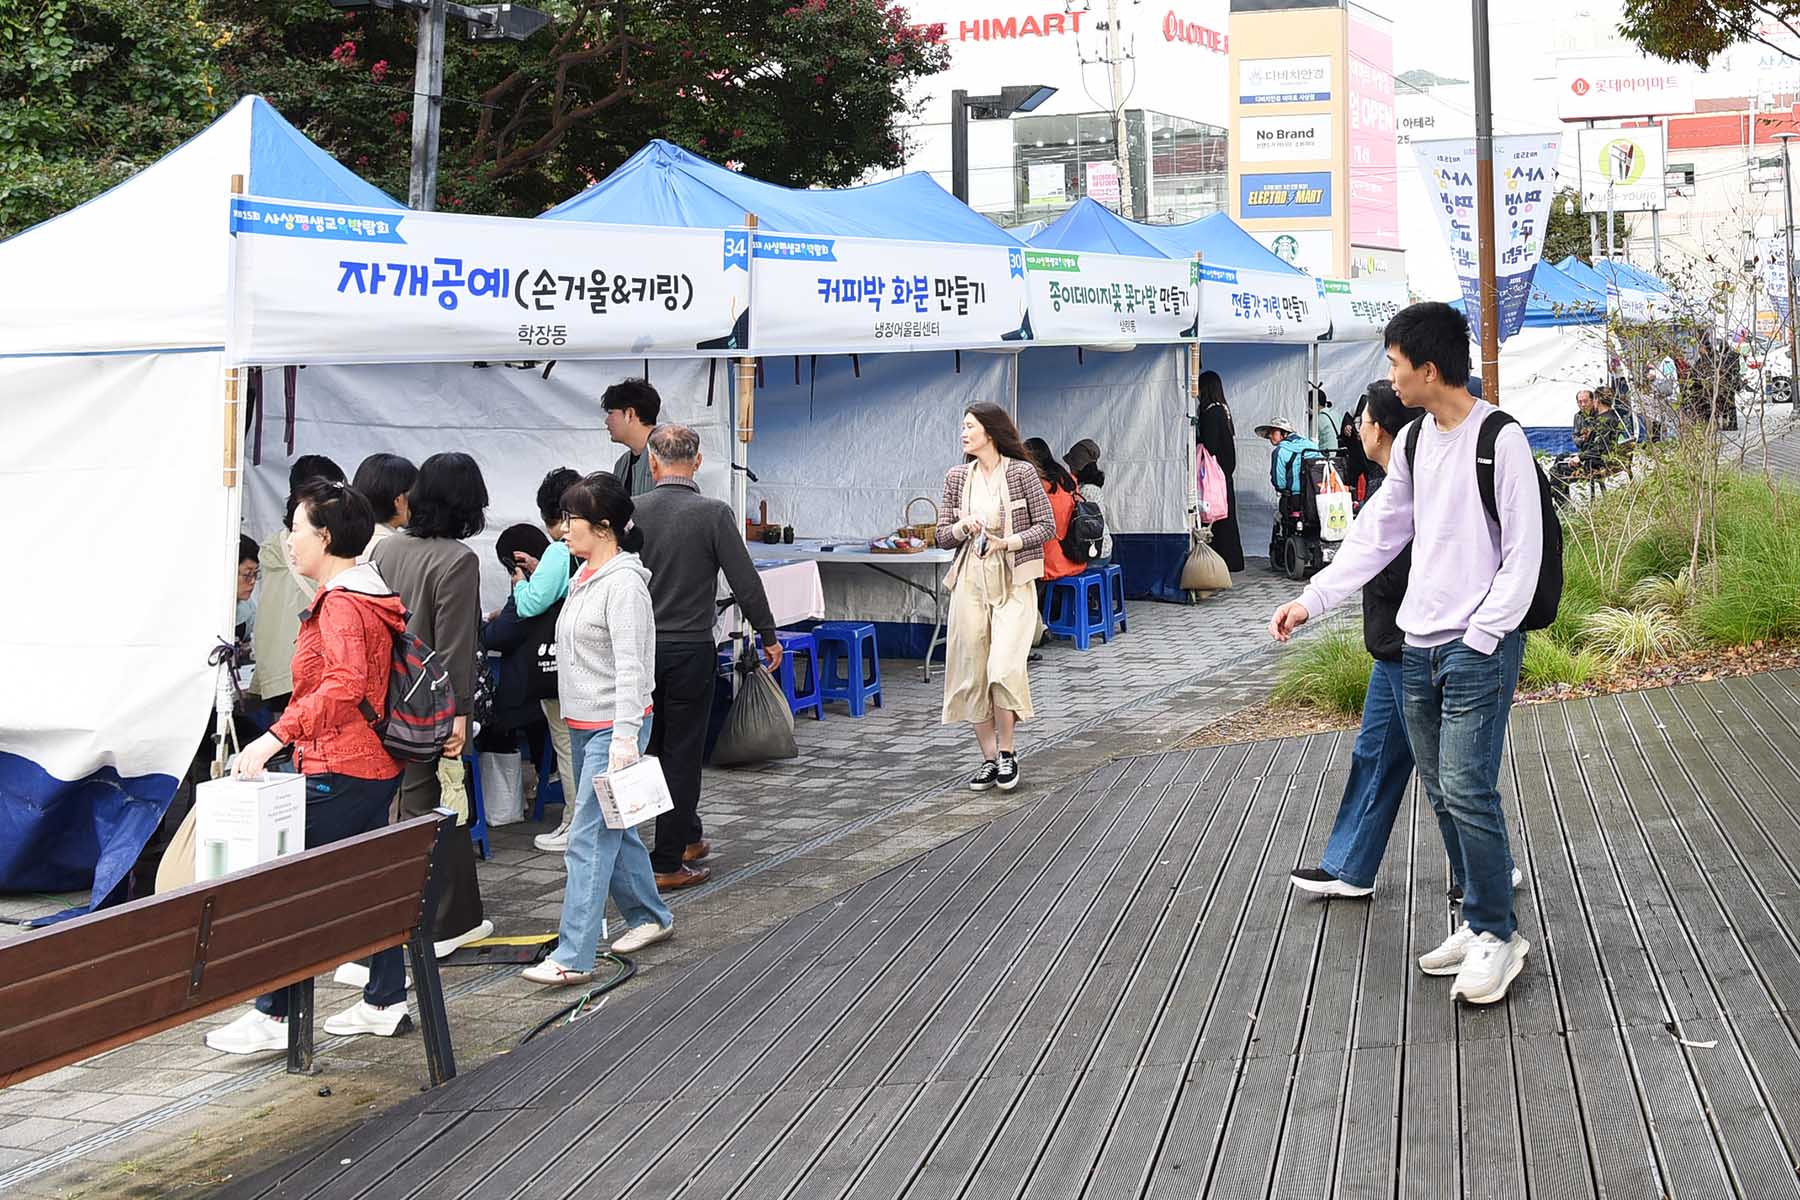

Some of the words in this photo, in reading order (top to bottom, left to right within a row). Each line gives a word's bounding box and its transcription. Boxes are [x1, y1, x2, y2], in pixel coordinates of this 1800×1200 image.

[959, 11, 1086, 42] HIMART
[1361, 97, 1393, 132] OPEN
[1256, 130, 1274, 140] No
[1276, 127, 1315, 140] Brand
[1247, 190, 1288, 206] ELECTRO
[1295, 189, 1324, 205] MART
[264, 212, 390, 237] 사상평생교육박람회
[724, 238, 747, 258] 34
[1010, 253, 1022, 269] 30
[337, 256, 695, 314] 자개공예(손거울&키링)
[817, 275, 886, 312] 커피박
[891, 275, 929, 313] 화분
[934, 276, 986, 316] 만들기
[1048, 280, 1122, 314] 종이데이지꽃
[1123, 283, 1158, 315] 꽃다발
[1159, 286, 1190, 317] 만들기
[1231, 293, 1261, 320] 전통갓
[1262, 295, 1281, 320] 키링
[1282, 296, 1309, 323] 만들기
[517, 323, 568, 346] 학장동
[874, 321, 941, 339] 냉정어울림센터
